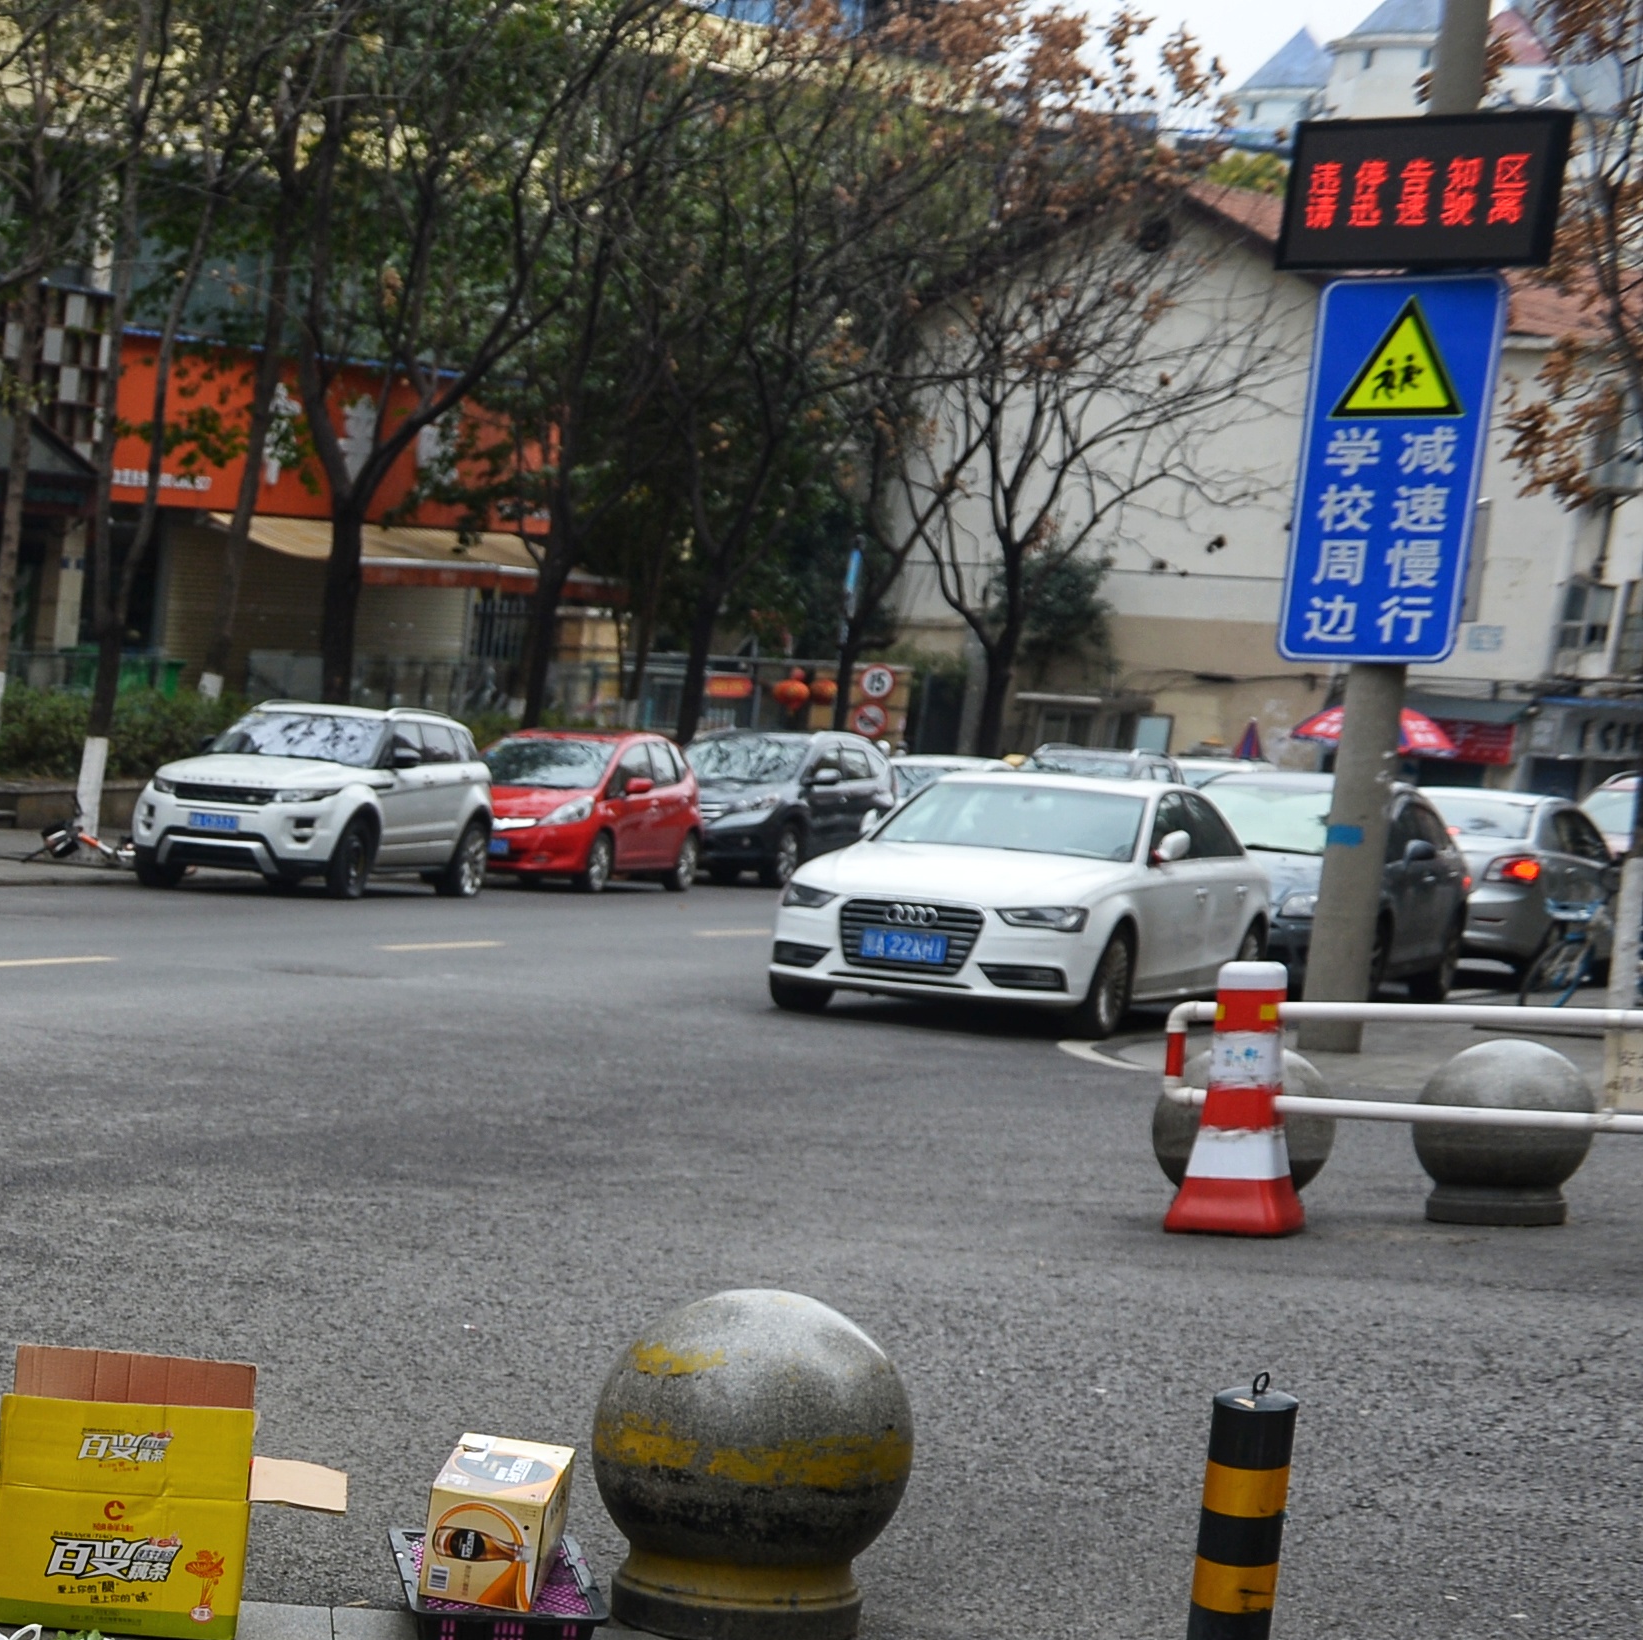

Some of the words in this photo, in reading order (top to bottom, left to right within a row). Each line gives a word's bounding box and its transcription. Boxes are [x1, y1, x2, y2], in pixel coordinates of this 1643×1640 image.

[1304, 426, 1382, 645] 学校周边
[1376, 424, 1460, 645] 减速慢行
